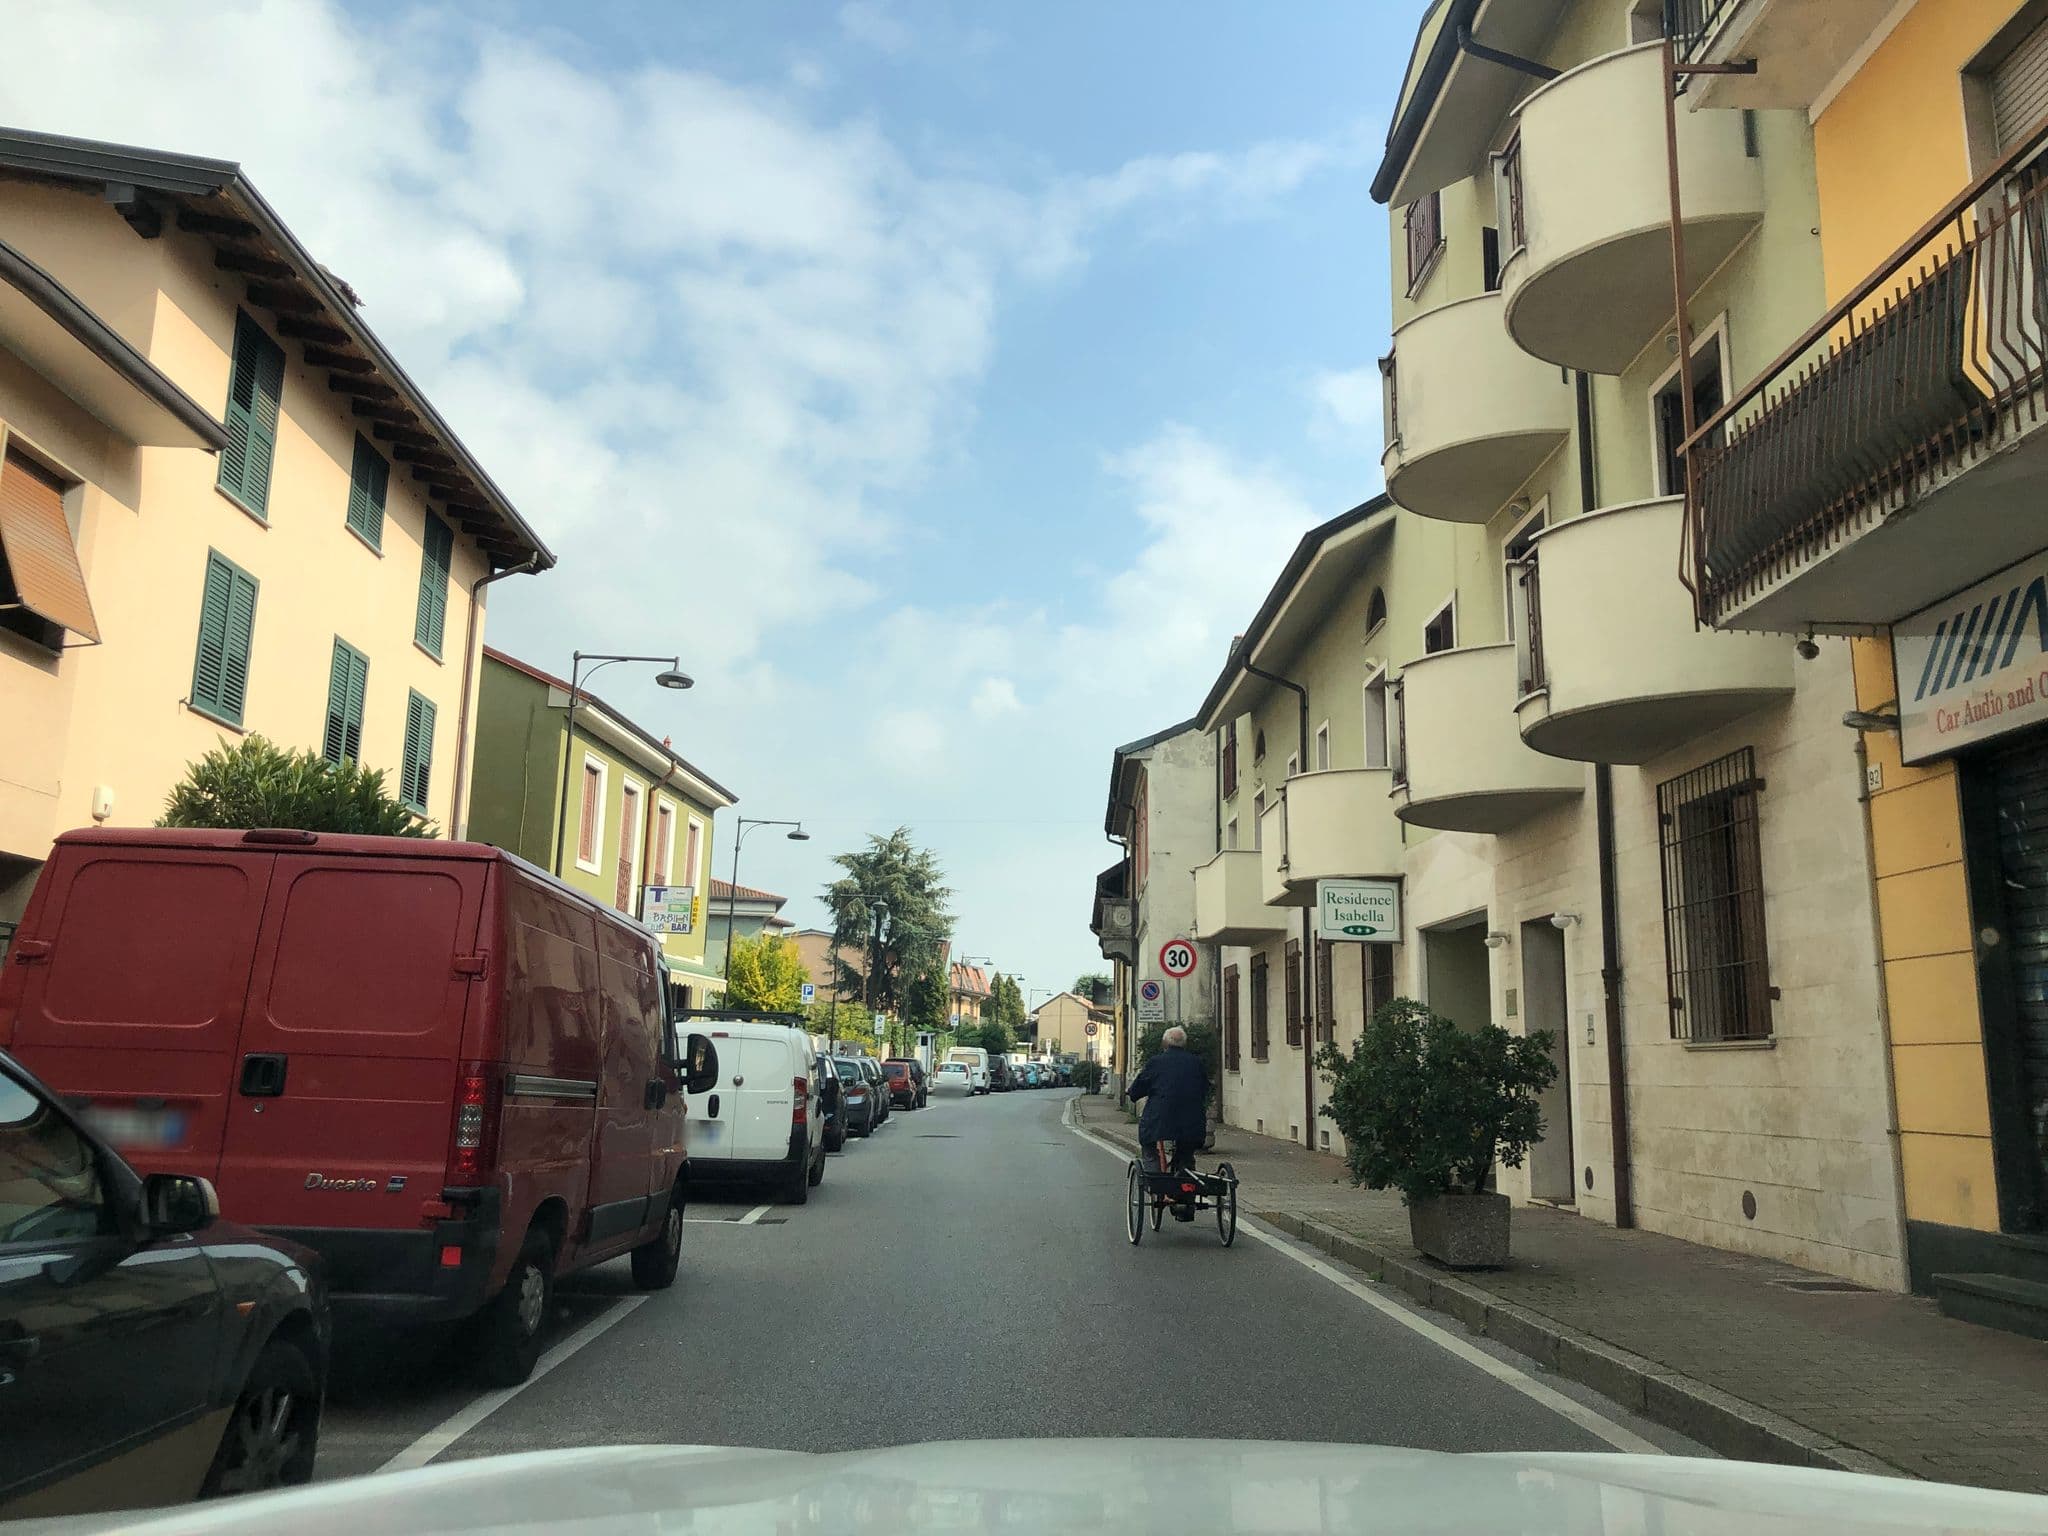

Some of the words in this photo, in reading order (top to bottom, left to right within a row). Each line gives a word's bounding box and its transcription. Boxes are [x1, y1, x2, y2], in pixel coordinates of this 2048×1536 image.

[1936, 708, 1960, 734] Car
[1964, 689, 2003, 725] Audio
[2008, 677, 2036, 710] and
[1326, 891, 1392, 906] Residence
[1334, 908, 1385, 922] Isabella
[671, 923, 688, 932] BAR
[1168, 949, 1189, 968] 30
[304, 1172, 377, 1192] Ducato
